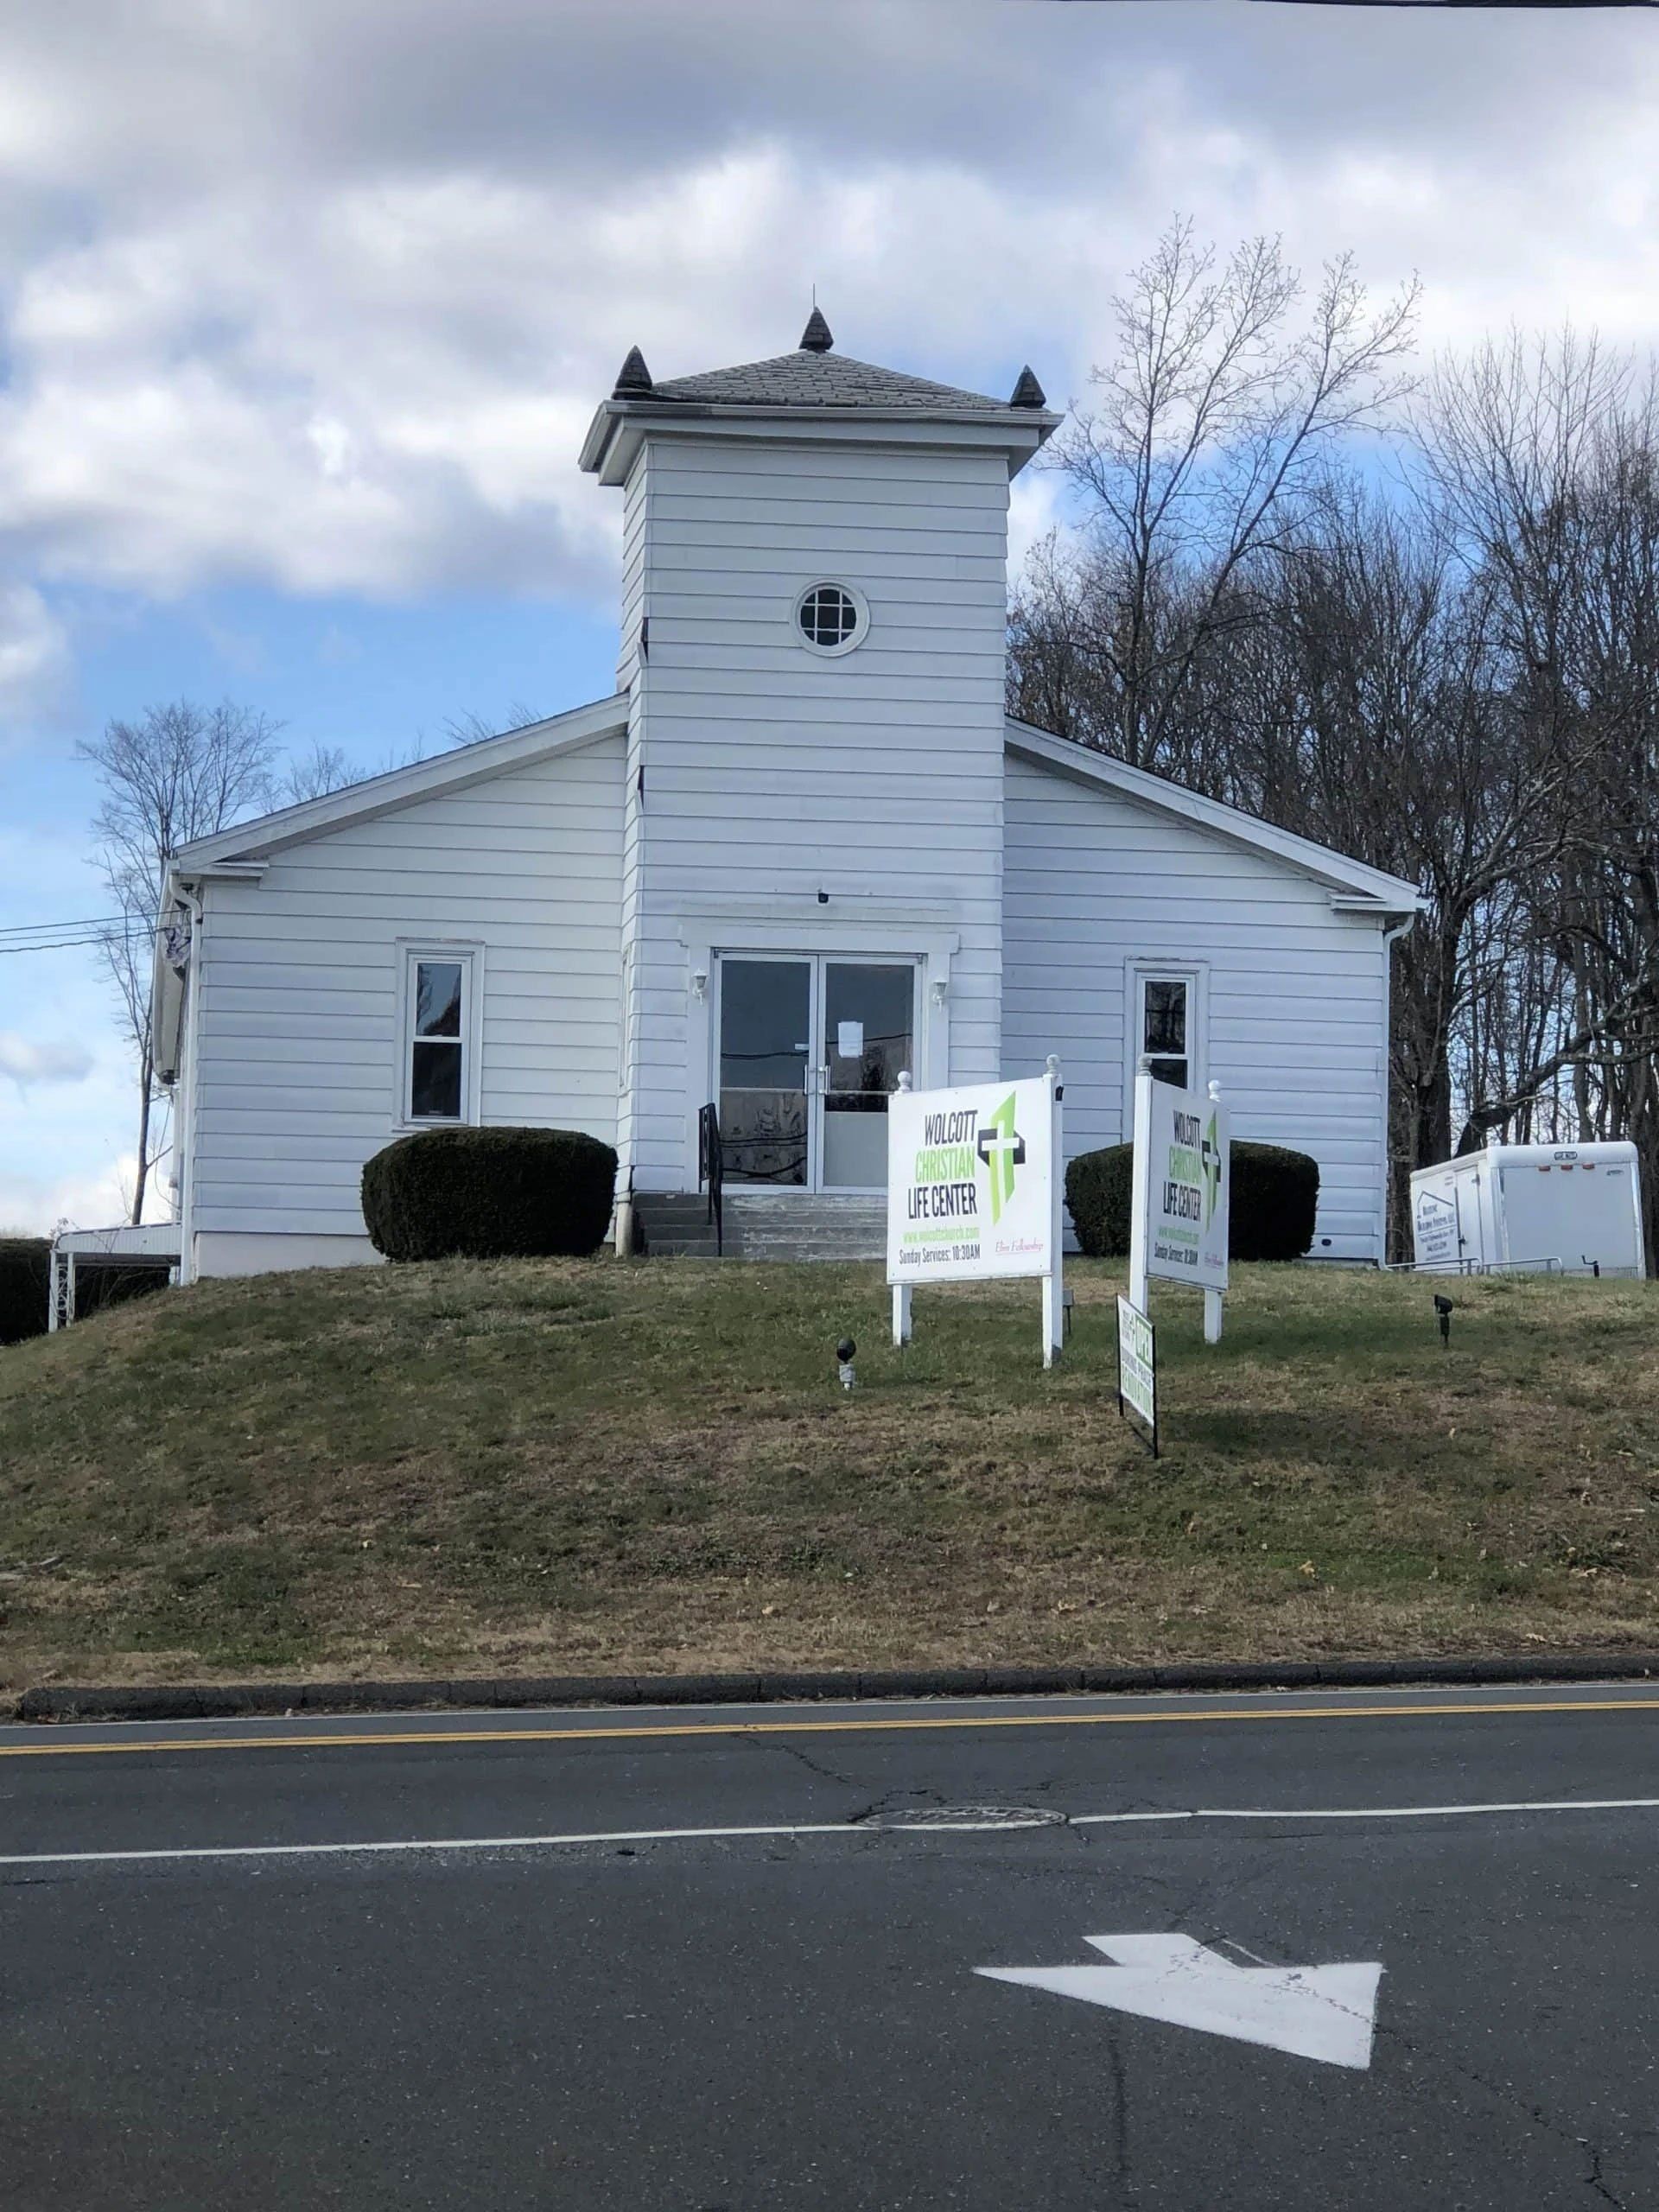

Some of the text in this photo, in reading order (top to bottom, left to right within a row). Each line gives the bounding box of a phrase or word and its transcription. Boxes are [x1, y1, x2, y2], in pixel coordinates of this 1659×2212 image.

[925, 1109, 978, 1146] WOLCOTT
[1173, 1109, 1200, 1148] WOLCOTT
[915, 1146, 975, 1183] CHRISTIAN
[907, 1182, 977, 1219] LIFE CENTER
[1163, 1180, 1201, 1222] LIFE CENTER
[899, 1244, 981, 1267] Sunday Services: 10:30AM
